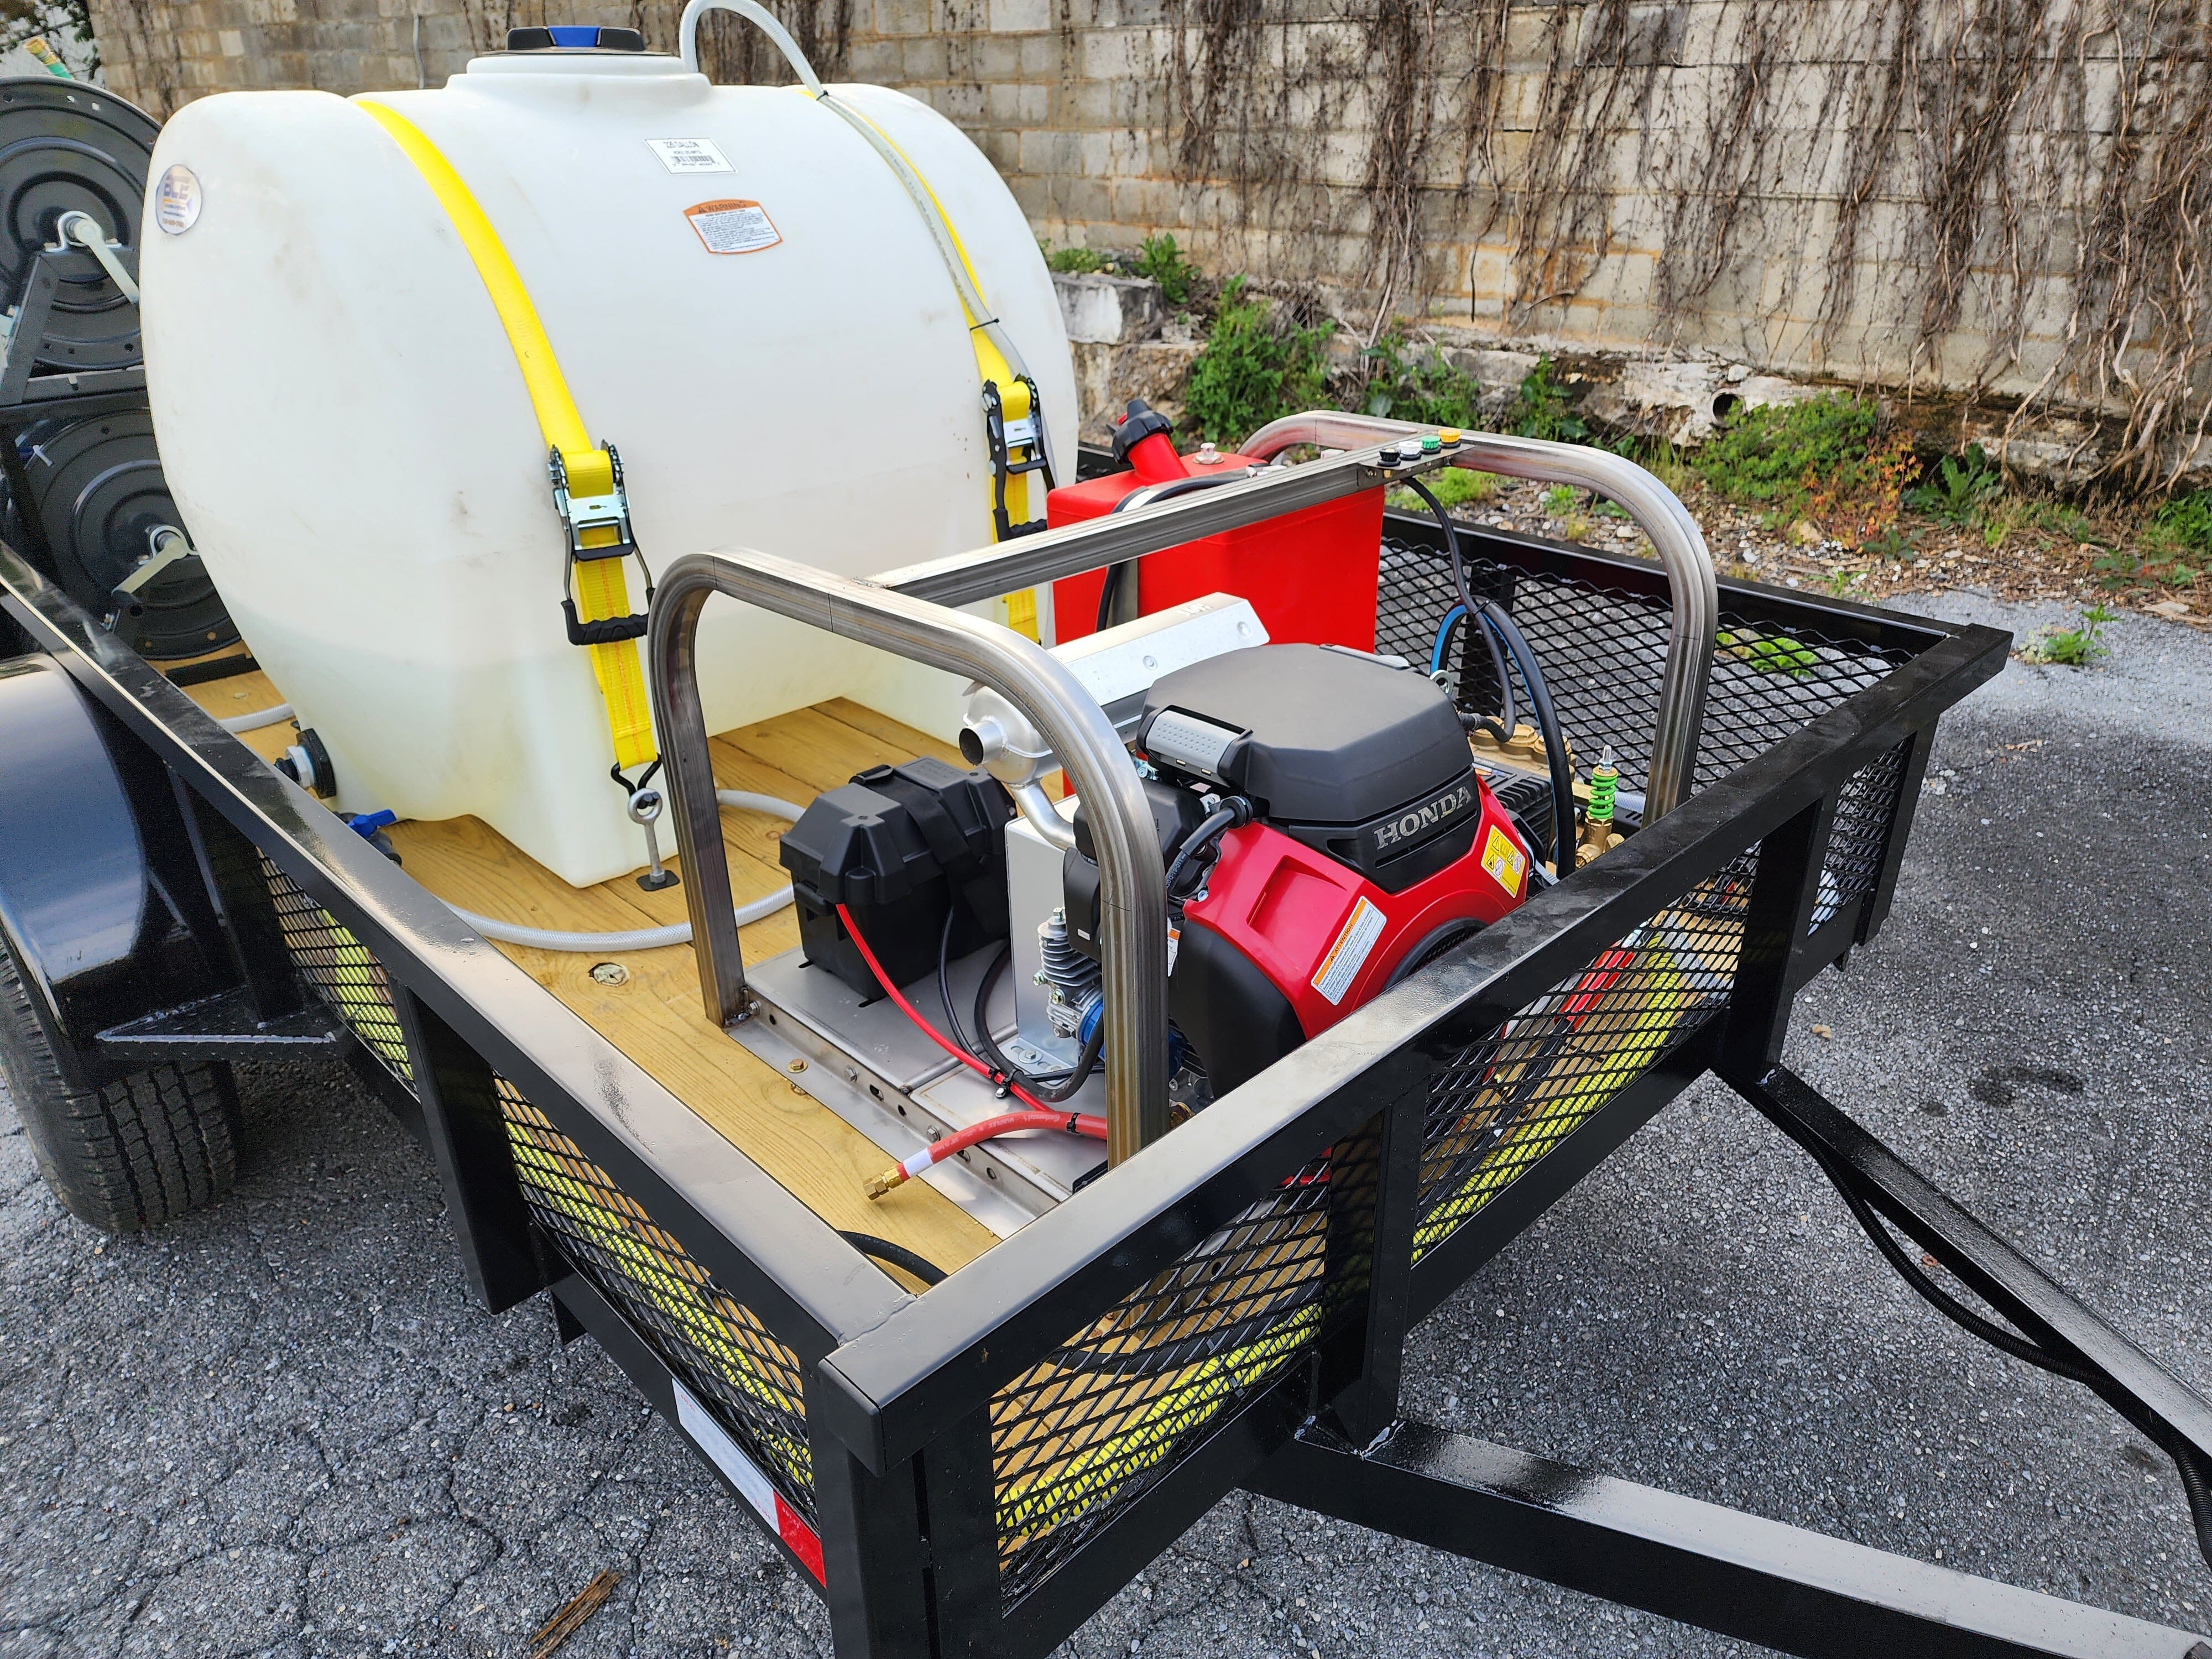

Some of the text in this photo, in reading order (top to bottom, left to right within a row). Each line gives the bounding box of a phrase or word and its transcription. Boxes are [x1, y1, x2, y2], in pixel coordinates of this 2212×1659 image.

[707, 201, 747, 212] WARNING
[1374, 786, 1472, 849] HONDA
[1333, 922, 1353, 954] ATTENTION
[1027, 1113, 1060, 1123] Continental
